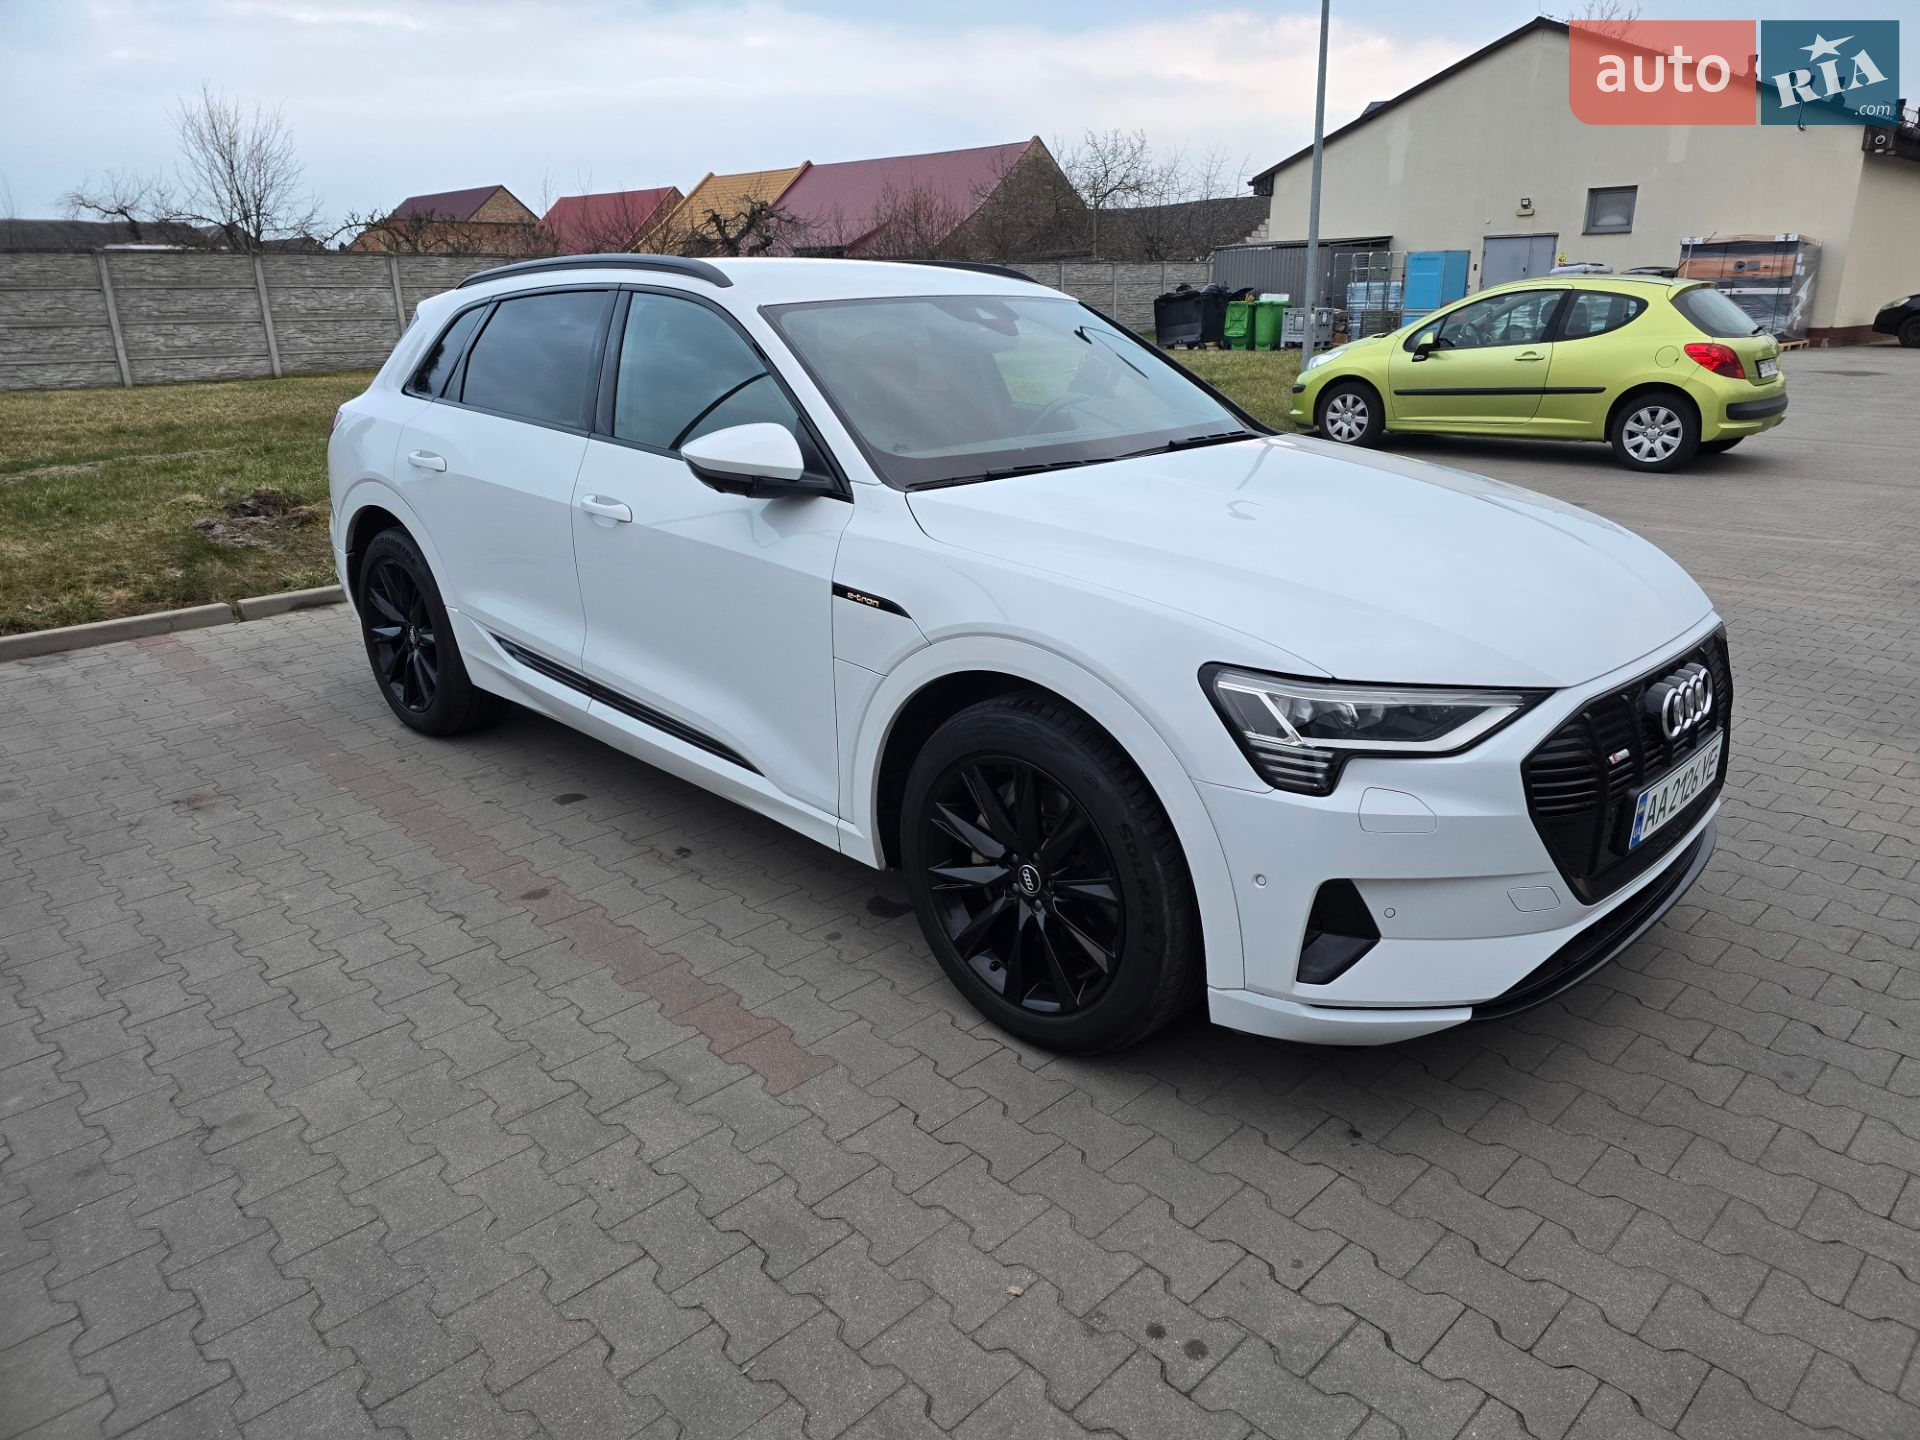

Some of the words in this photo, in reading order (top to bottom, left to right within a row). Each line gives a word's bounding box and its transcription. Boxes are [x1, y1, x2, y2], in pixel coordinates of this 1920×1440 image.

[847, 592, 880, 607] e-tron
[1643, 785, 1668, 832] AA
[1668, 759, 1702, 814] 2126
[1701, 744, 1719, 786] YE
